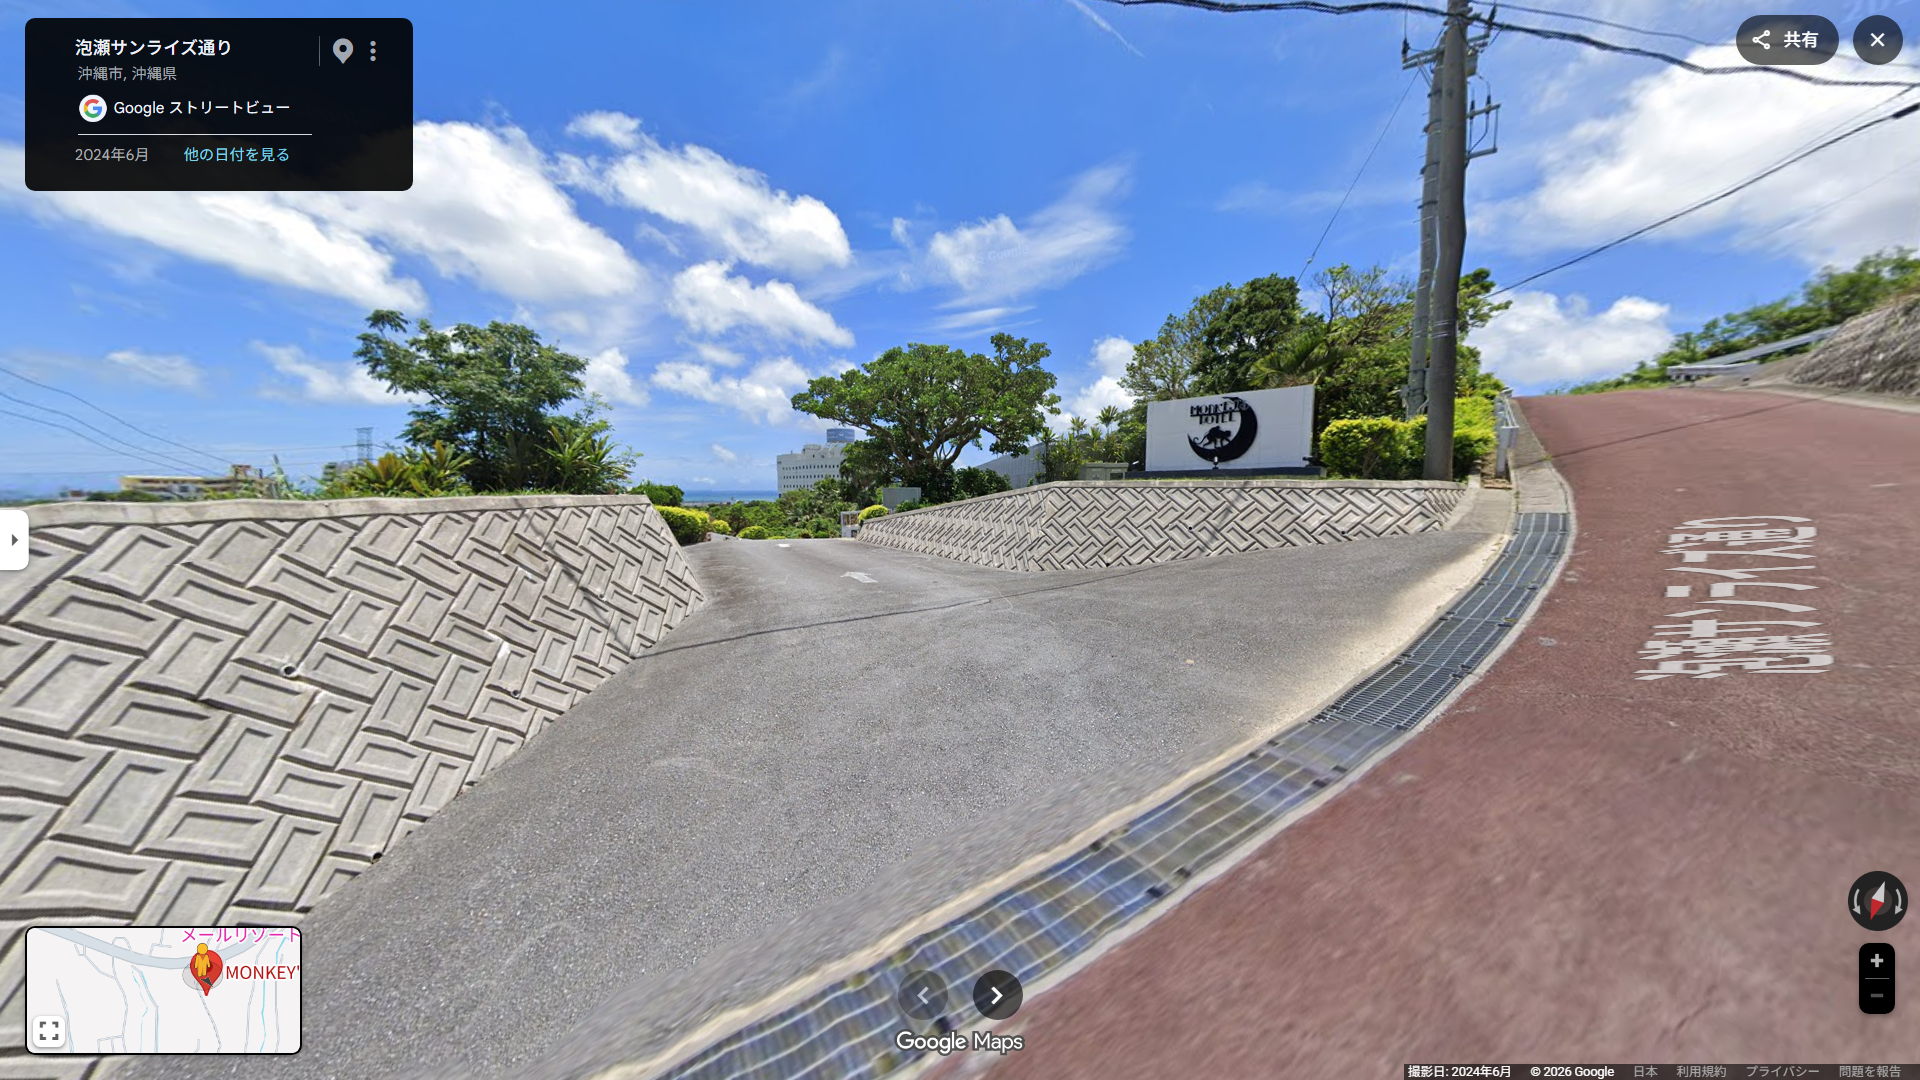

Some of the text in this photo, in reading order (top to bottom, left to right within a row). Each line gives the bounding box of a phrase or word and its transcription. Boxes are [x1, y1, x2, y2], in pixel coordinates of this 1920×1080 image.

[1633, 515, 1834, 681] 泡瀬サンライズ通り
